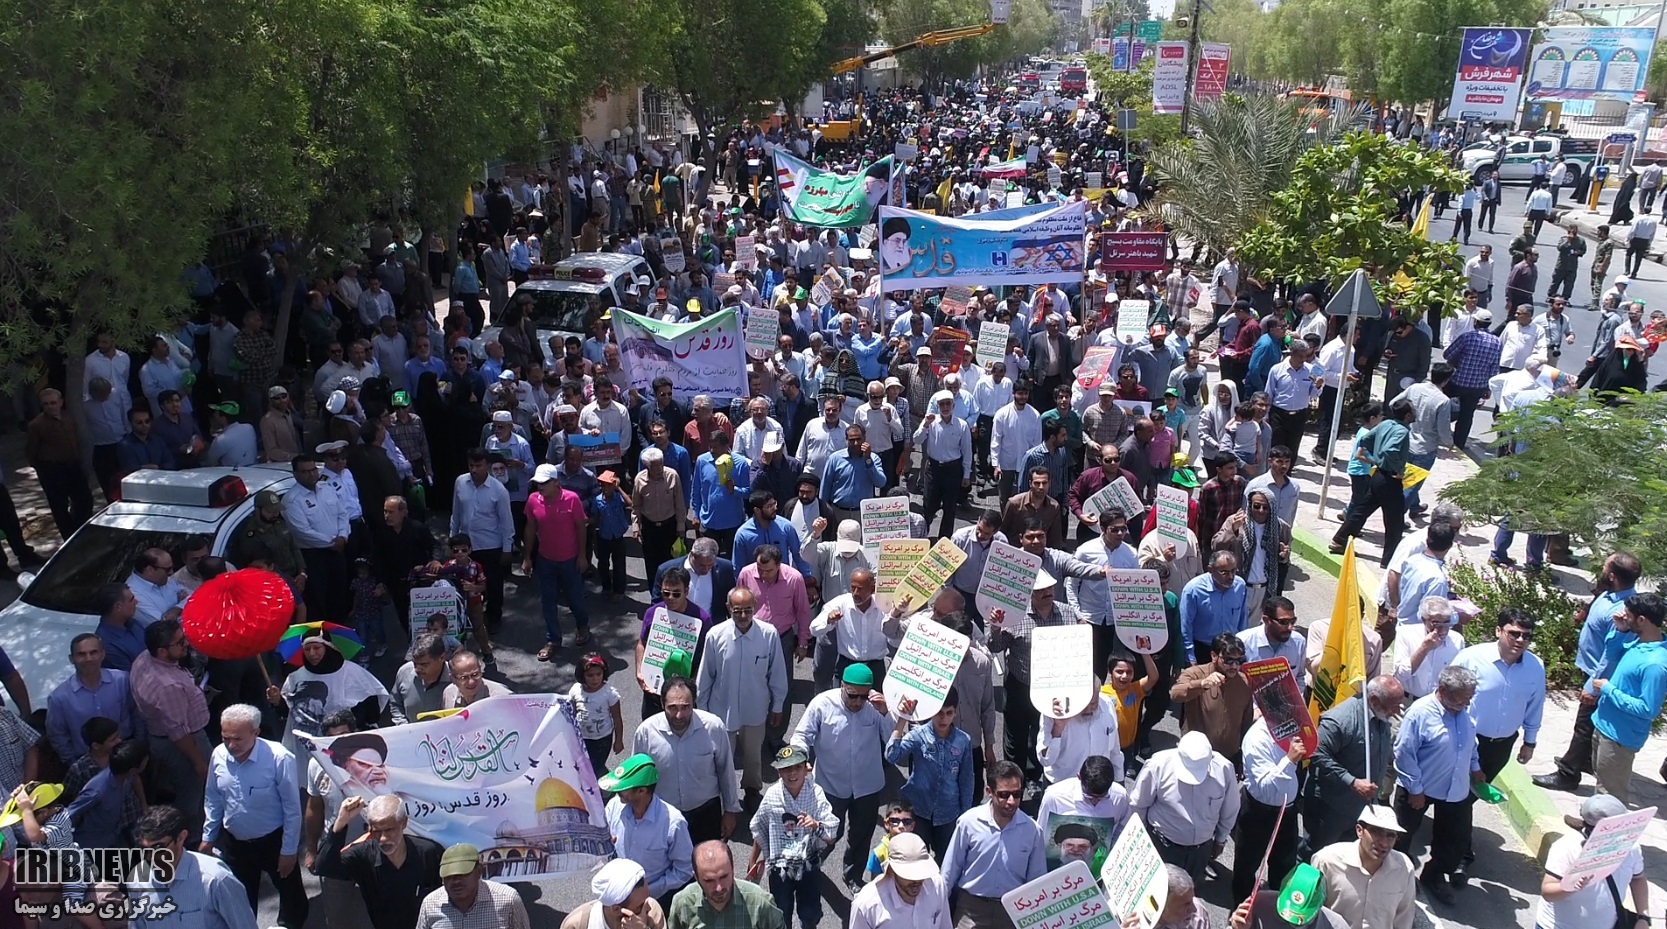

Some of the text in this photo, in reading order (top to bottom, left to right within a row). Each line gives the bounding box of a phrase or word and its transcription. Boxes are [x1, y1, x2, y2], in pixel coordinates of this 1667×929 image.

[1466, 84, 1478, 92] ویژه
[1122, 238, 1144, 246] مقاومت
[1145, 238, 1162, 247] پایگاه
[1126, 250, 1142, 258] باهنر
[1142, 250, 1158, 258] شهید
[674, 326, 735, 359] روز قدس
[677, 368, 692, 380] مردم
[702, 366, 728, 378] حمایت
[891, 501, 904, 509] مرگ
[864, 519, 885, 527] اسرائیل
[883, 544, 902, 553] امریکا
[910, 544, 923, 553] مرگ
[995, 547, 1014, 559] امریکا
[1022, 558, 1034, 568] مرگ
[988, 564, 1010, 575] اسرائیل
[1018, 576, 1031, 585] مرگ
[1111, 574, 1131, 584] امریکا
[1140, 575, 1154, 584] مرگ
[982, 583, 1006, 592] انگلیس
[1013, 592, 1026, 602] مرگ
[1114, 593, 1136, 602] اسرائیل
[1145, 594, 1158, 603] مرگ
[659, 614, 677, 625] امریکا
[1116, 611, 1139, 620] انگلیس
[1148, 612, 1162, 621] مرگ
[684, 622, 696, 632] مرگ
[917, 622, 939, 637] امریکا
[653, 632, 674, 642] اسرائیل
[681, 640, 693, 649] مرگ
[908, 633, 958, 660] DOWN WITH U.S.A
[947, 638, 962, 649] مرگ
[905, 643, 932, 656] اسرائیل
[899, 651, 950, 677] DOWN WITH ISRAEL
[940, 658, 955, 669] مرگ
[896, 666, 924, 677] انگلیس
[890, 670, 944, 698] DOWN WITH ENGLAND
[932, 678, 947, 689] مرگ
[485, 792, 507, 808] روز
[414, 801, 436, 817] روز
[1014, 876, 1083, 910] مرگ بر امریکا
[1020, 887, 1095, 926] DOWN WITH U.S.A
[1069, 902, 1101, 925] مرگ بر
[1083, 914, 1109, 929] ISRAEL
